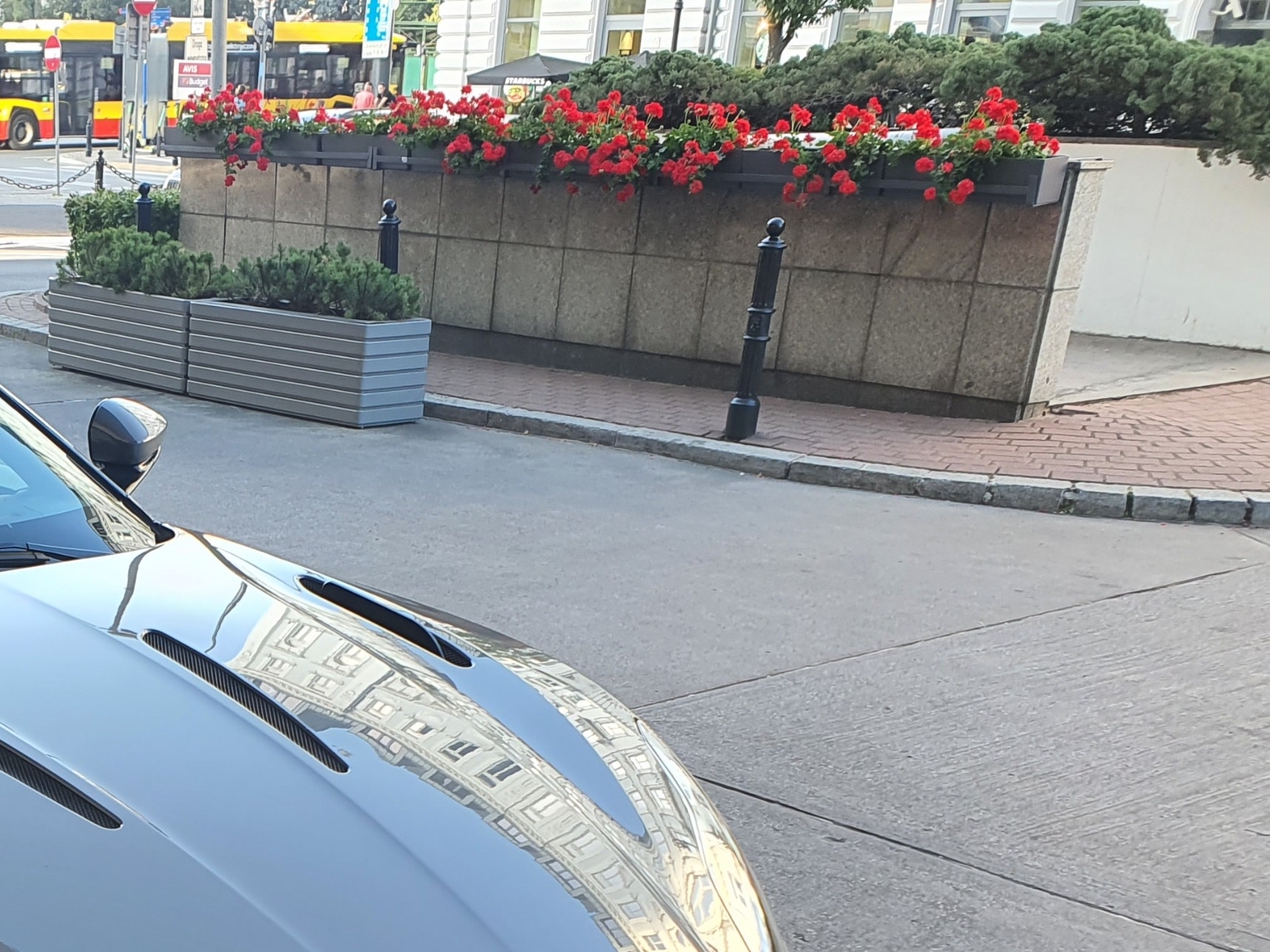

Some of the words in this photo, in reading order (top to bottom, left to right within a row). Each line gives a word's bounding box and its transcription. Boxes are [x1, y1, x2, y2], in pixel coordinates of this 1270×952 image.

[182, 64, 198, 73] AVIS
[189, 77, 208, 87] Budget
[505, 77, 546, 85] STARBUCKS
